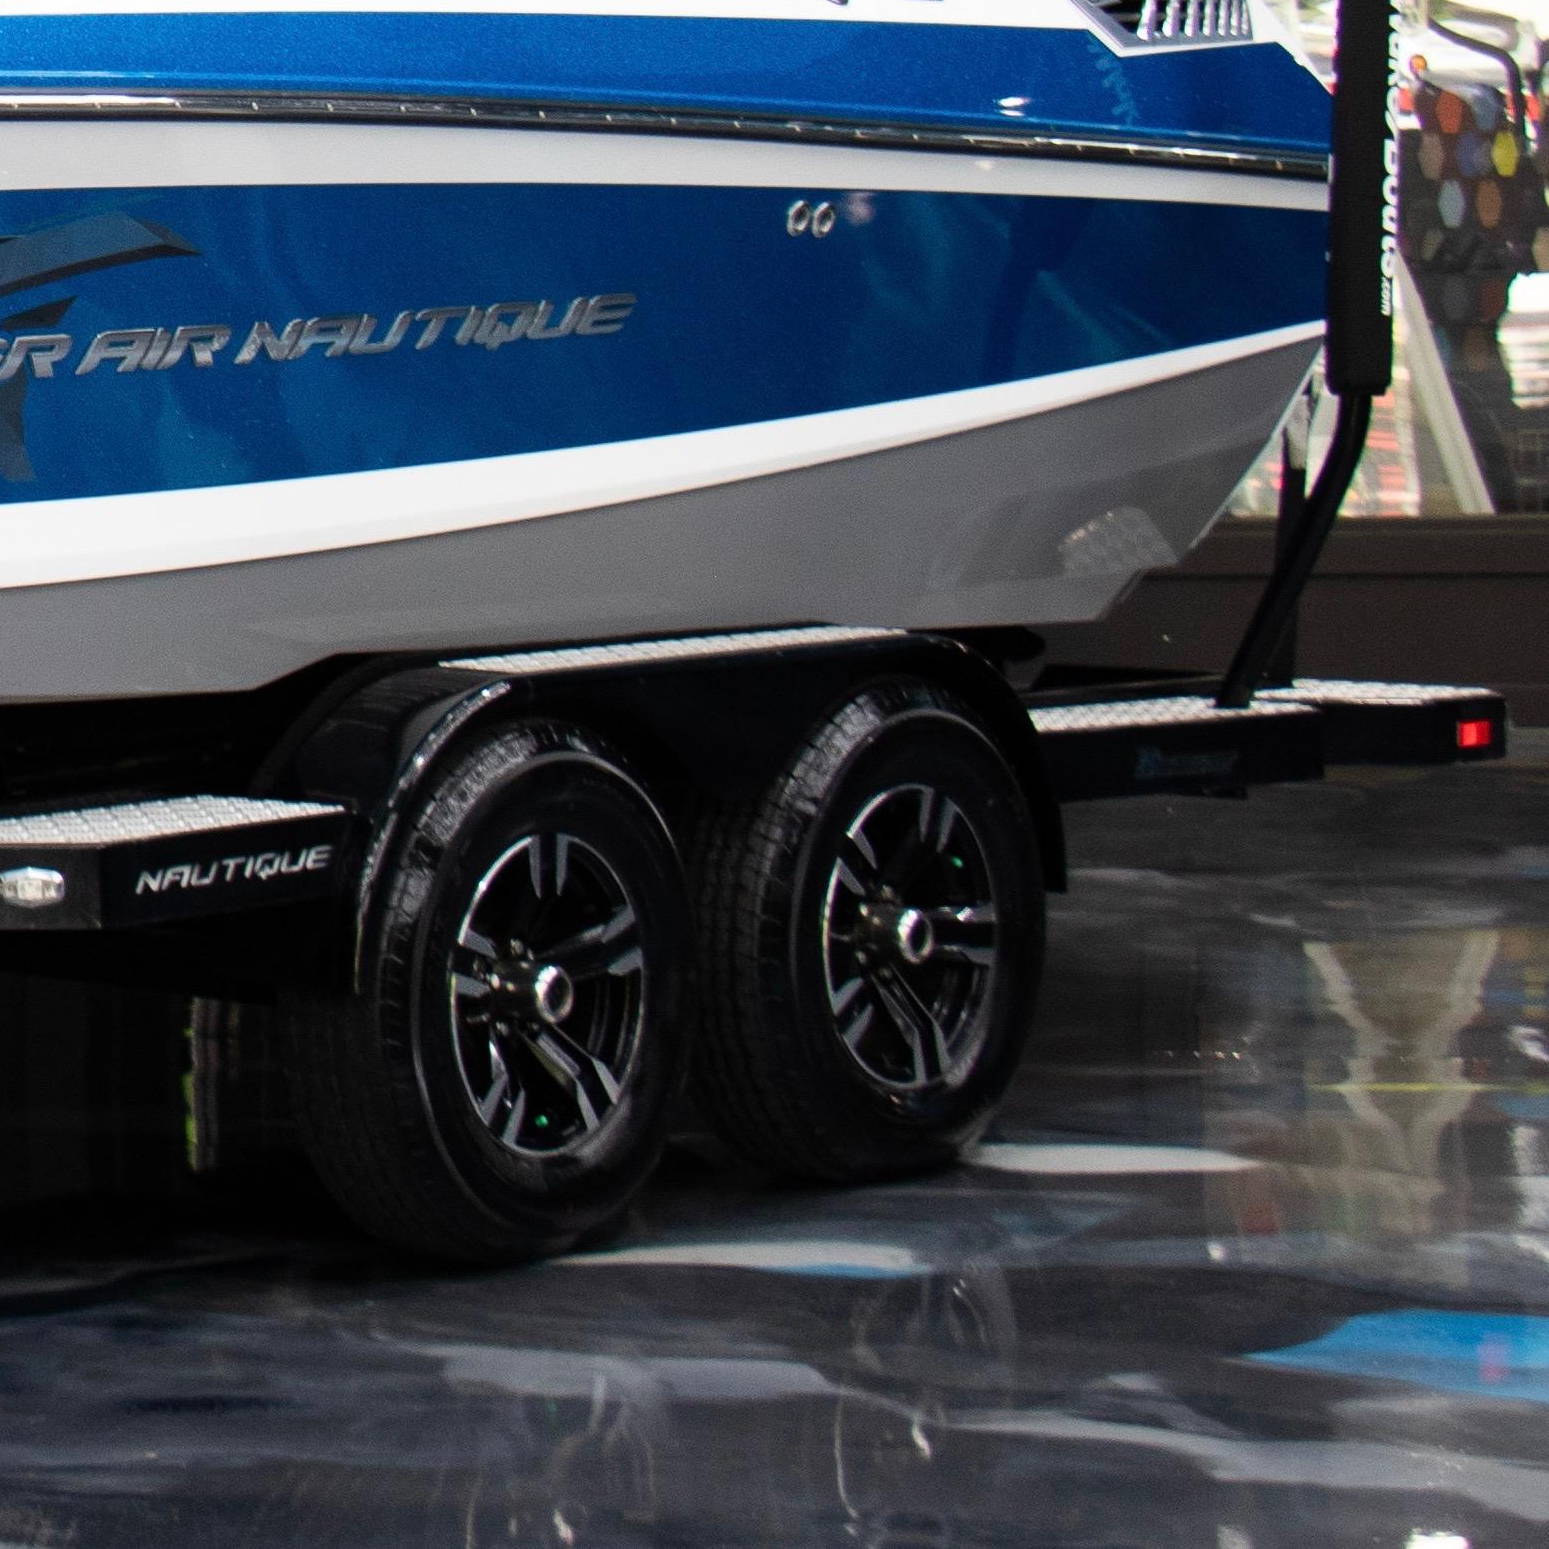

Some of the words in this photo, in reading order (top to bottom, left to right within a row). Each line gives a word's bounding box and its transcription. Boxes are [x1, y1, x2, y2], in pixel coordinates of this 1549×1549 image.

[74, 322, 233, 376] AIR
[232, 292, 639, 366] NAUTIQUE
[135, 845, 333, 895] NAUTIQUE
